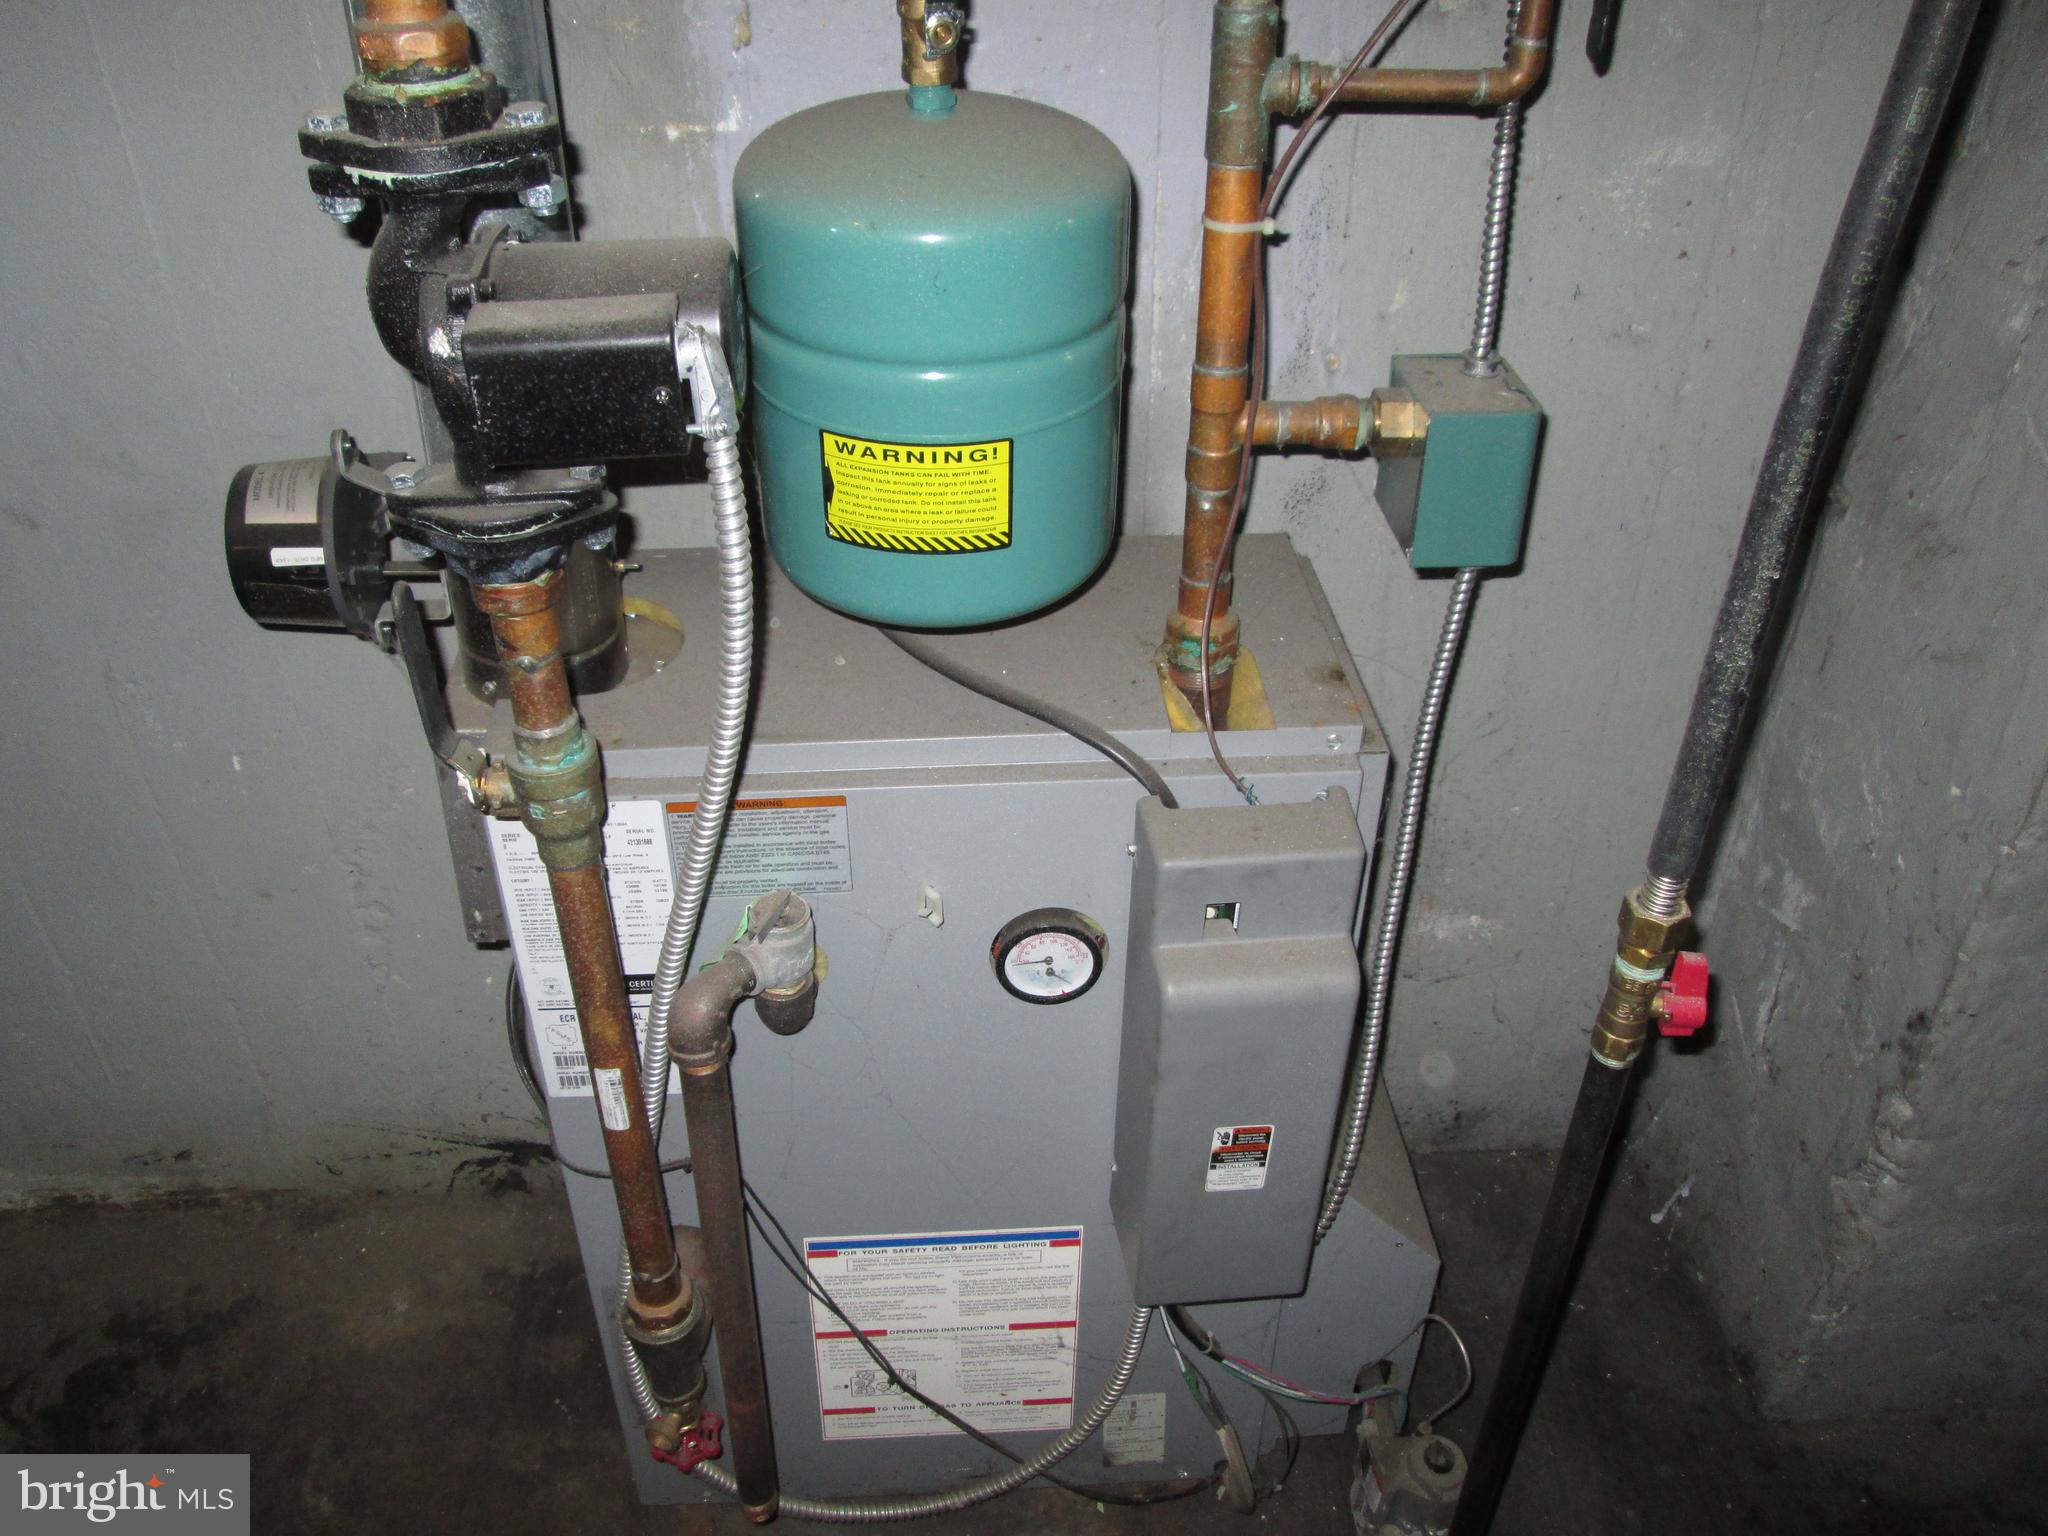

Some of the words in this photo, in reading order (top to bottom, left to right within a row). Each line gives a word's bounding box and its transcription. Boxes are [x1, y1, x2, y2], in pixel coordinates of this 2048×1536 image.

[834, 440, 997, 464] WARNING!
[836, 470, 860, 480] Inspect
[850, 465, 889, 475] EXPANSION
[836, 481, 872, 490] corrosion.
[875, 487, 922, 496] Immediately
[866, 514, 897, 522] personal
[900, 516, 920, 524] injury
[736, 800, 784, 808] WARNING
[560, 1015, 576, 1023] ECR
